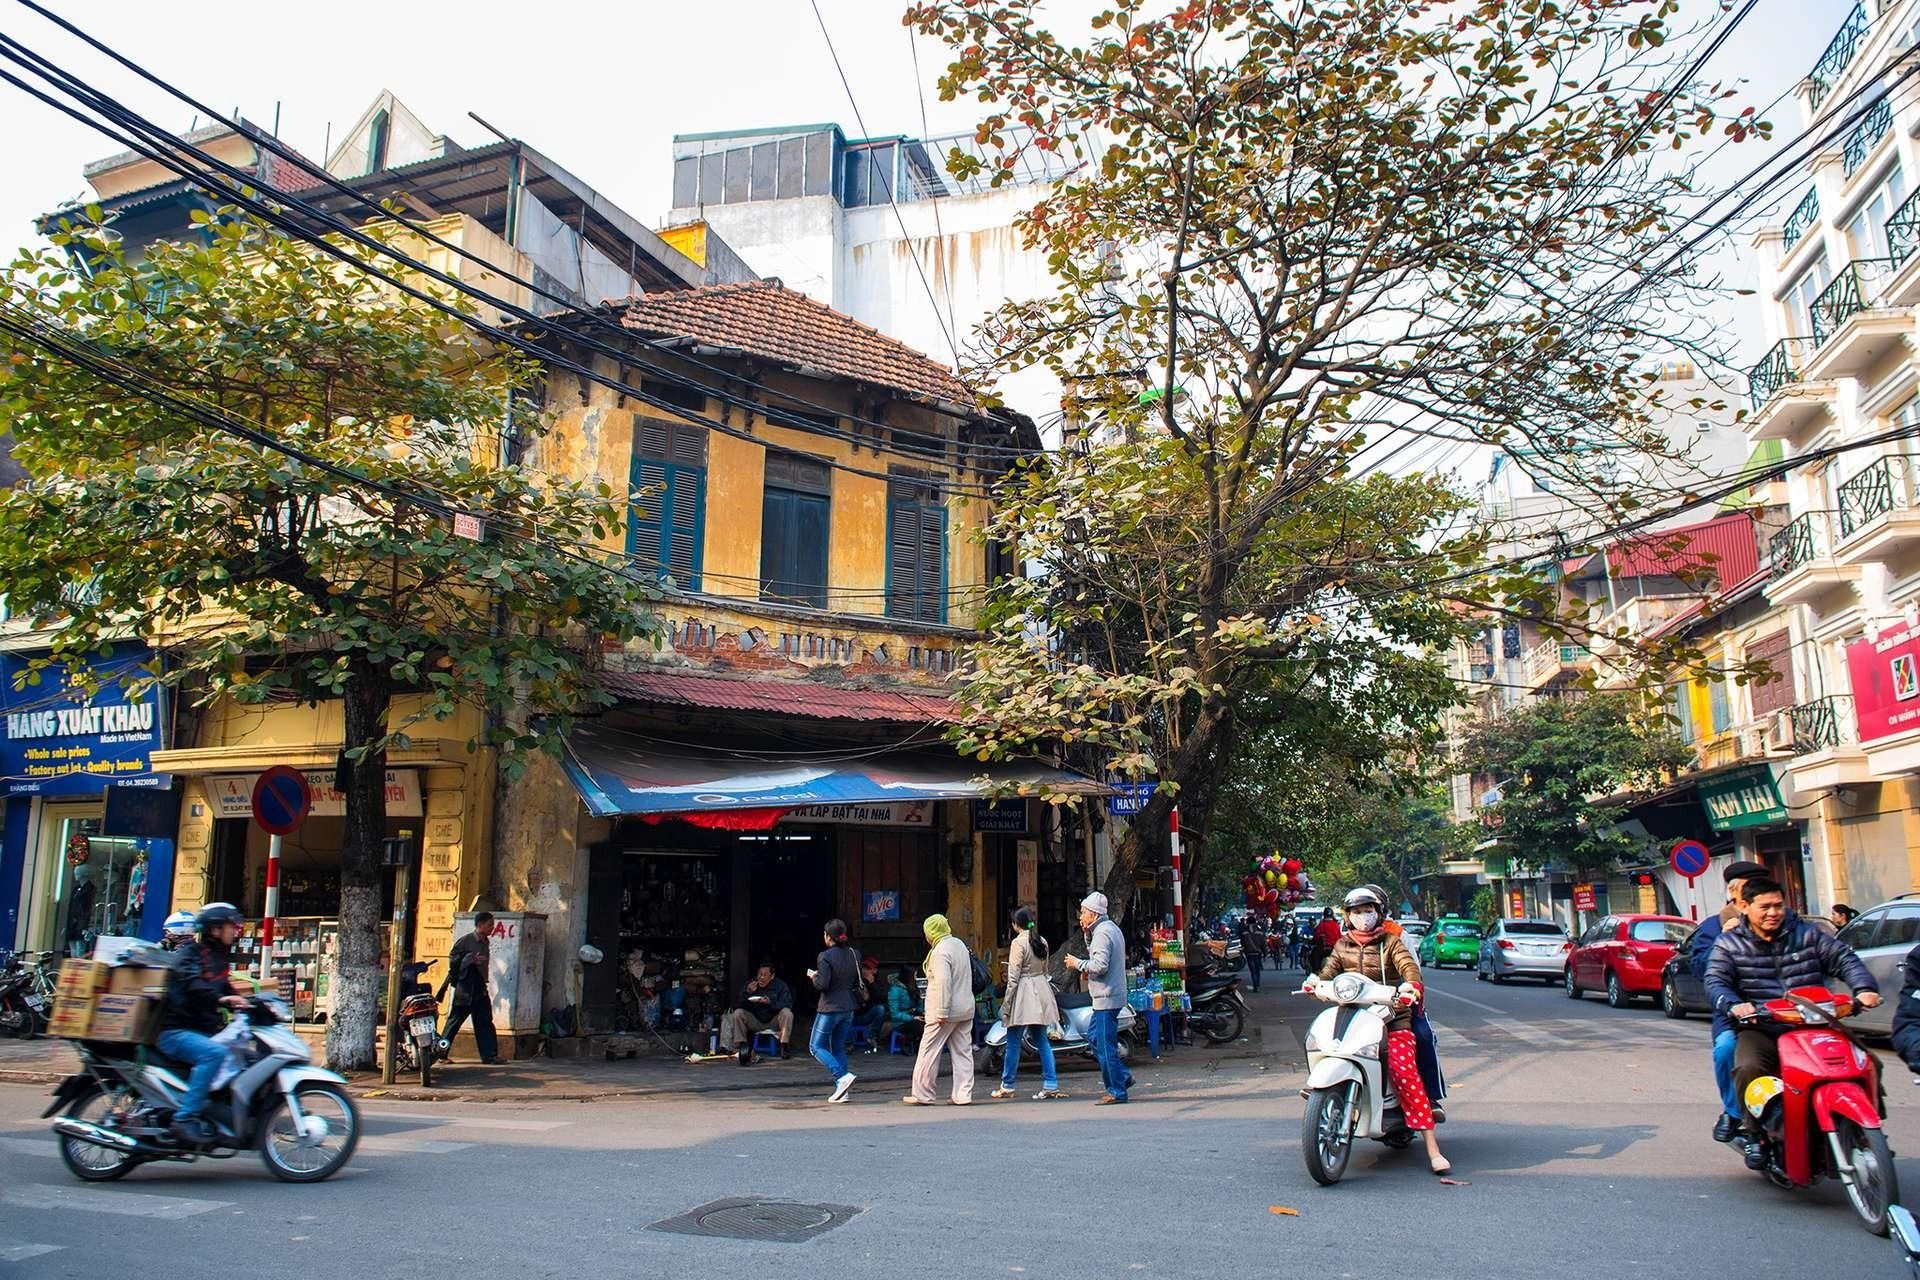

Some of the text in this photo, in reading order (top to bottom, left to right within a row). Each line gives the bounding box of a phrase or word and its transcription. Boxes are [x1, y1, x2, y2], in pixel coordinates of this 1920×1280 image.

[57, 698, 101, 736] XUẤT
[100, 734, 117, 743] Made
[118, 734, 124, 742] in
[27, 745, 91, 760] Whole sale prices
[29, 764, 55, 777] Factory
[87, 761, 115, 774] Quality
[116, 758, 143, 771] brands
[1706, 791, 1743, 820] NAM
[1740, 777, 1777, 814] HẢI
